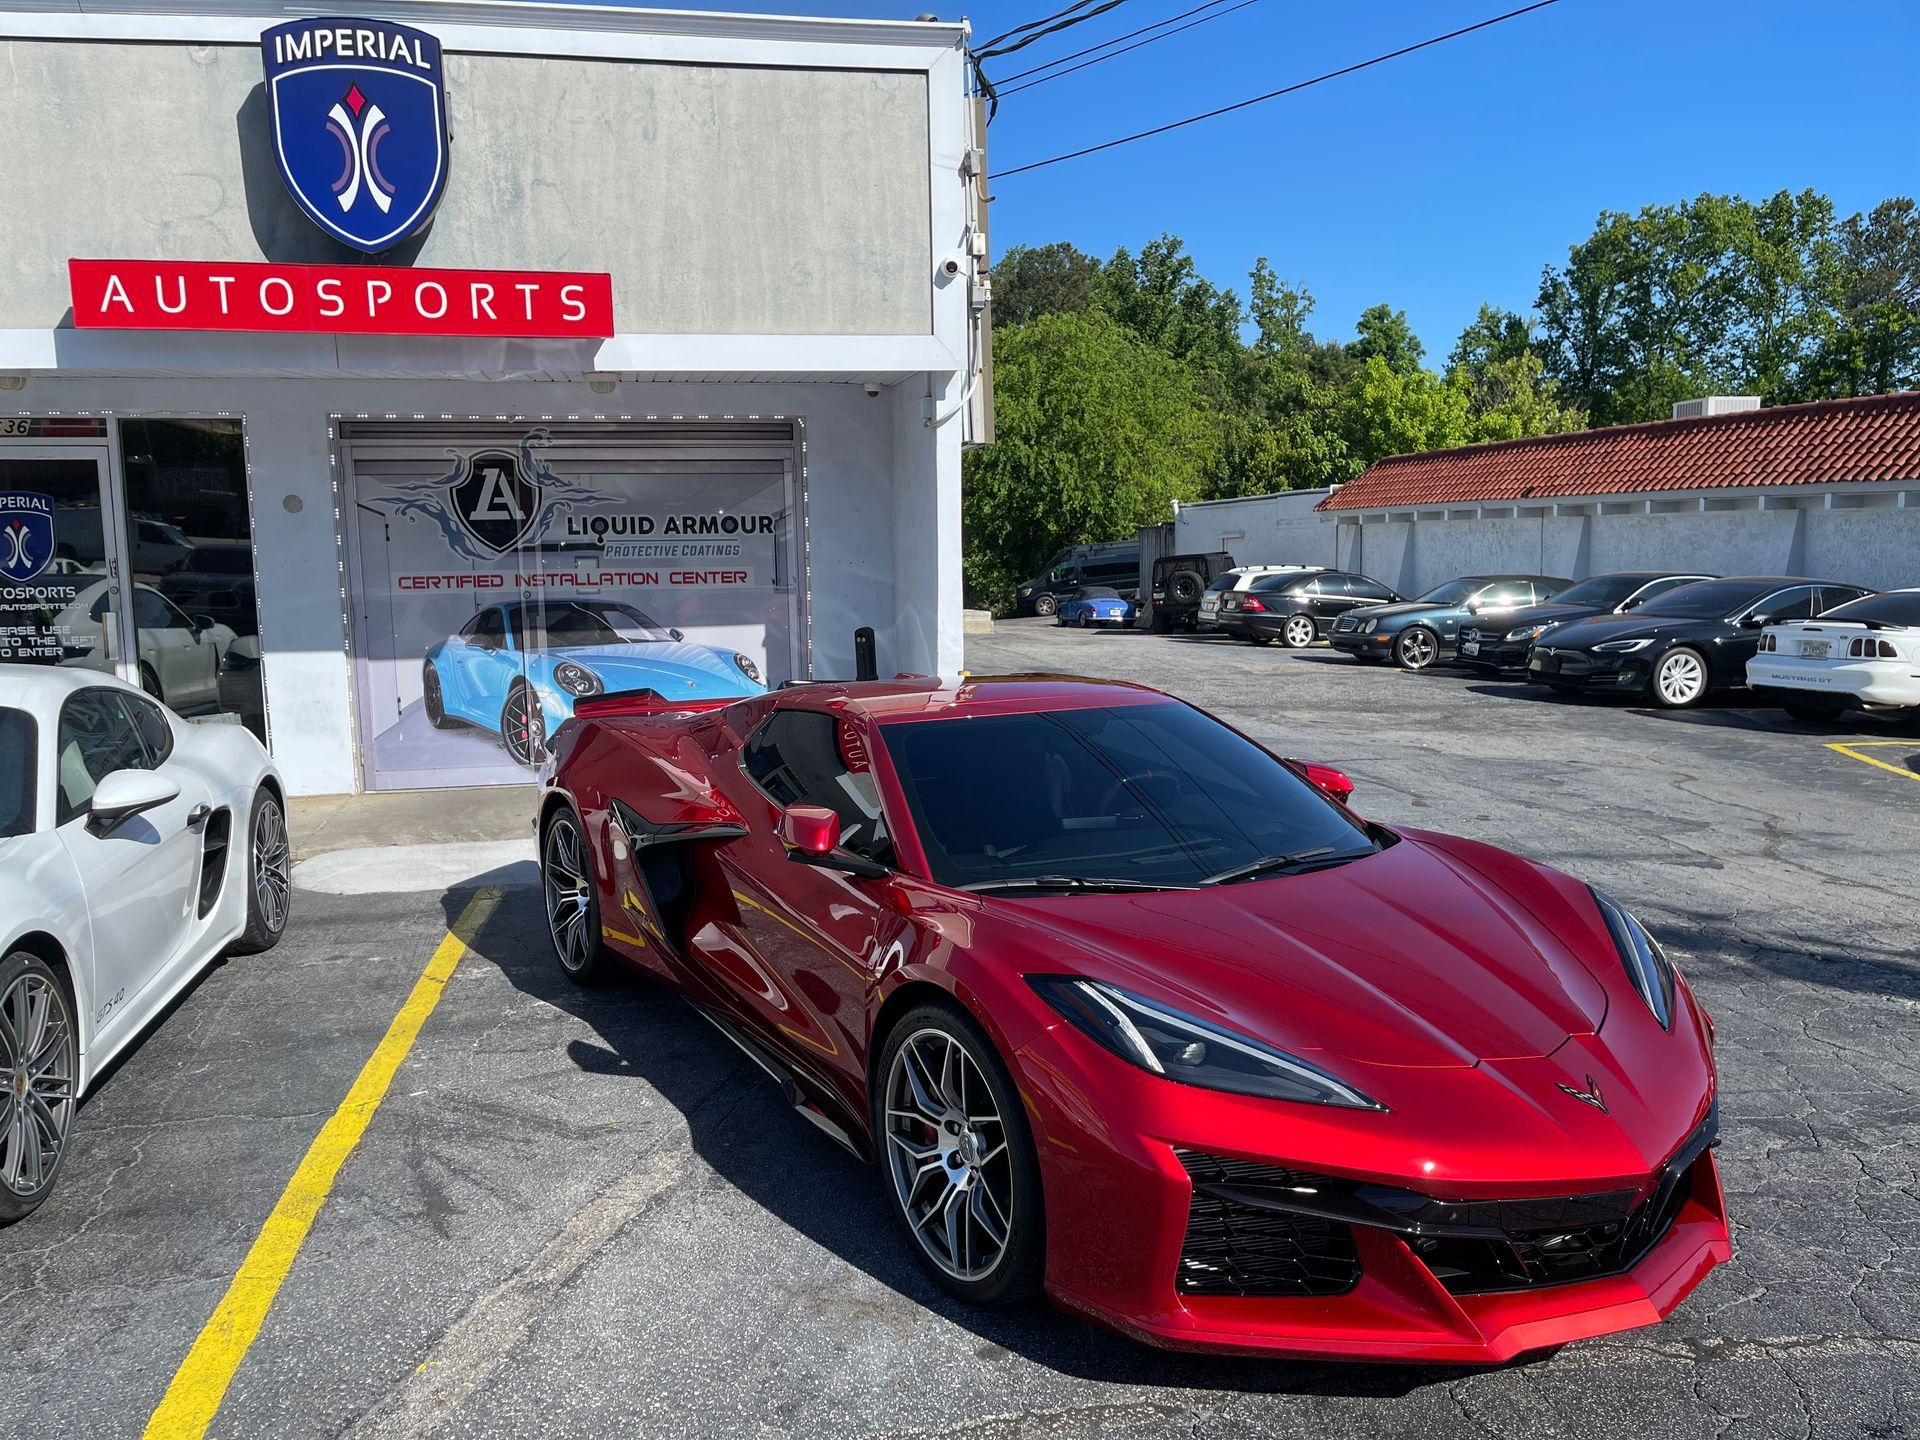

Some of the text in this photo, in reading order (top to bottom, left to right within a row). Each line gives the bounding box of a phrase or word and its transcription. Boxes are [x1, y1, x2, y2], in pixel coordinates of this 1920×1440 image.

[275, 29, 431, 69] IMPERIAL
[100, 274, 587, 321] AUTOSPORTS
[0, 420, 28, 433] 36
[567, 515, 774, 543] LIQUID ARMOUR
[605, 545, 741, 557] PROTECTIVE COATINGS
[398, 571, 748, 589] CERTIFIED INSTALLATION CENTER
[42, 625, 71, 635] USE
[28, 636, 56, 646] THE
[63, 635, 97, 646] LEFT
[18, 647, 64, 657] ENTER
